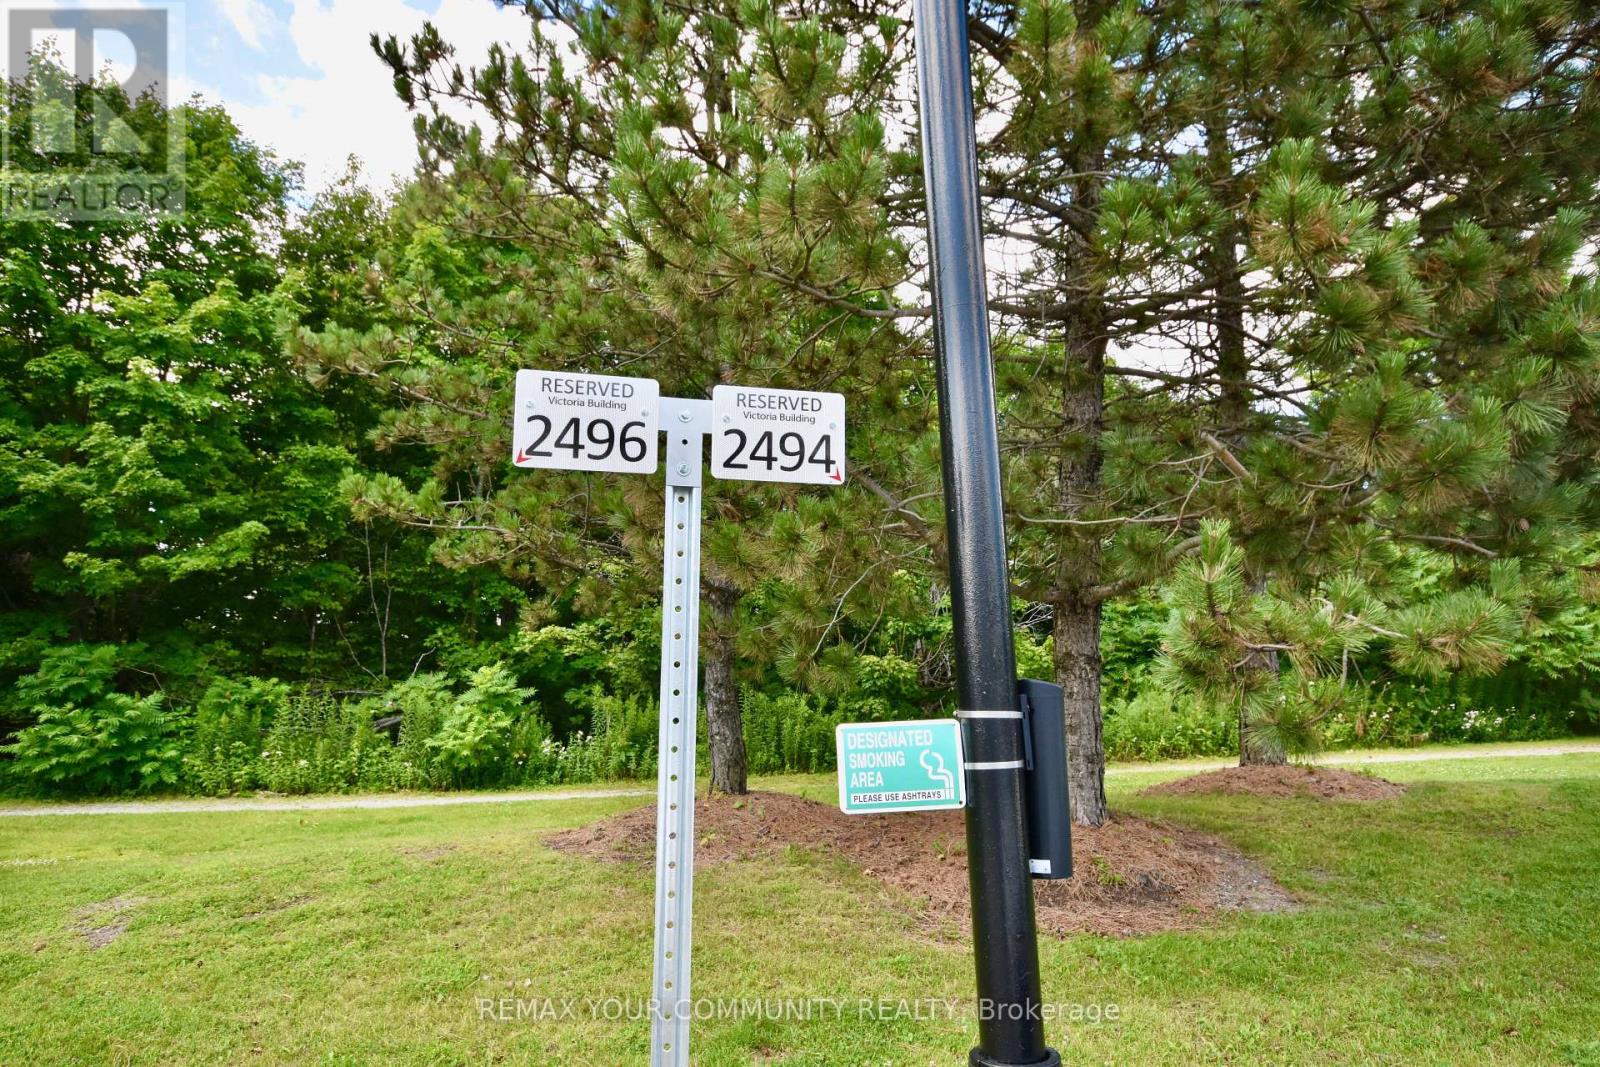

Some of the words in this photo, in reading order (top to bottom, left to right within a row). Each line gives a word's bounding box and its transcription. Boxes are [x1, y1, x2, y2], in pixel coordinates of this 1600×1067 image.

[541, 377, 634, 399] RESERVED
[548, 396, 585, 408] Victoria
[587, 399, 627, 412] Building
[736, 392, 823, 412] RESERVED
[743, 411, 777, 421] Victoria
[779, 413, 816, 425] Building
[525, 414, 647, 462] 2496
[722, 428, 836, 473] 2494
[848, 730, 932, 749] DESIGNATED
[848, 751, 906, 769] SMOKING
[850, 772, 884, 788] AREA
[853, 794, 883, 803] PLEASE
[884, 793, 900, 802] USE
[901, 790, 942, 800] ASHTRAYS
